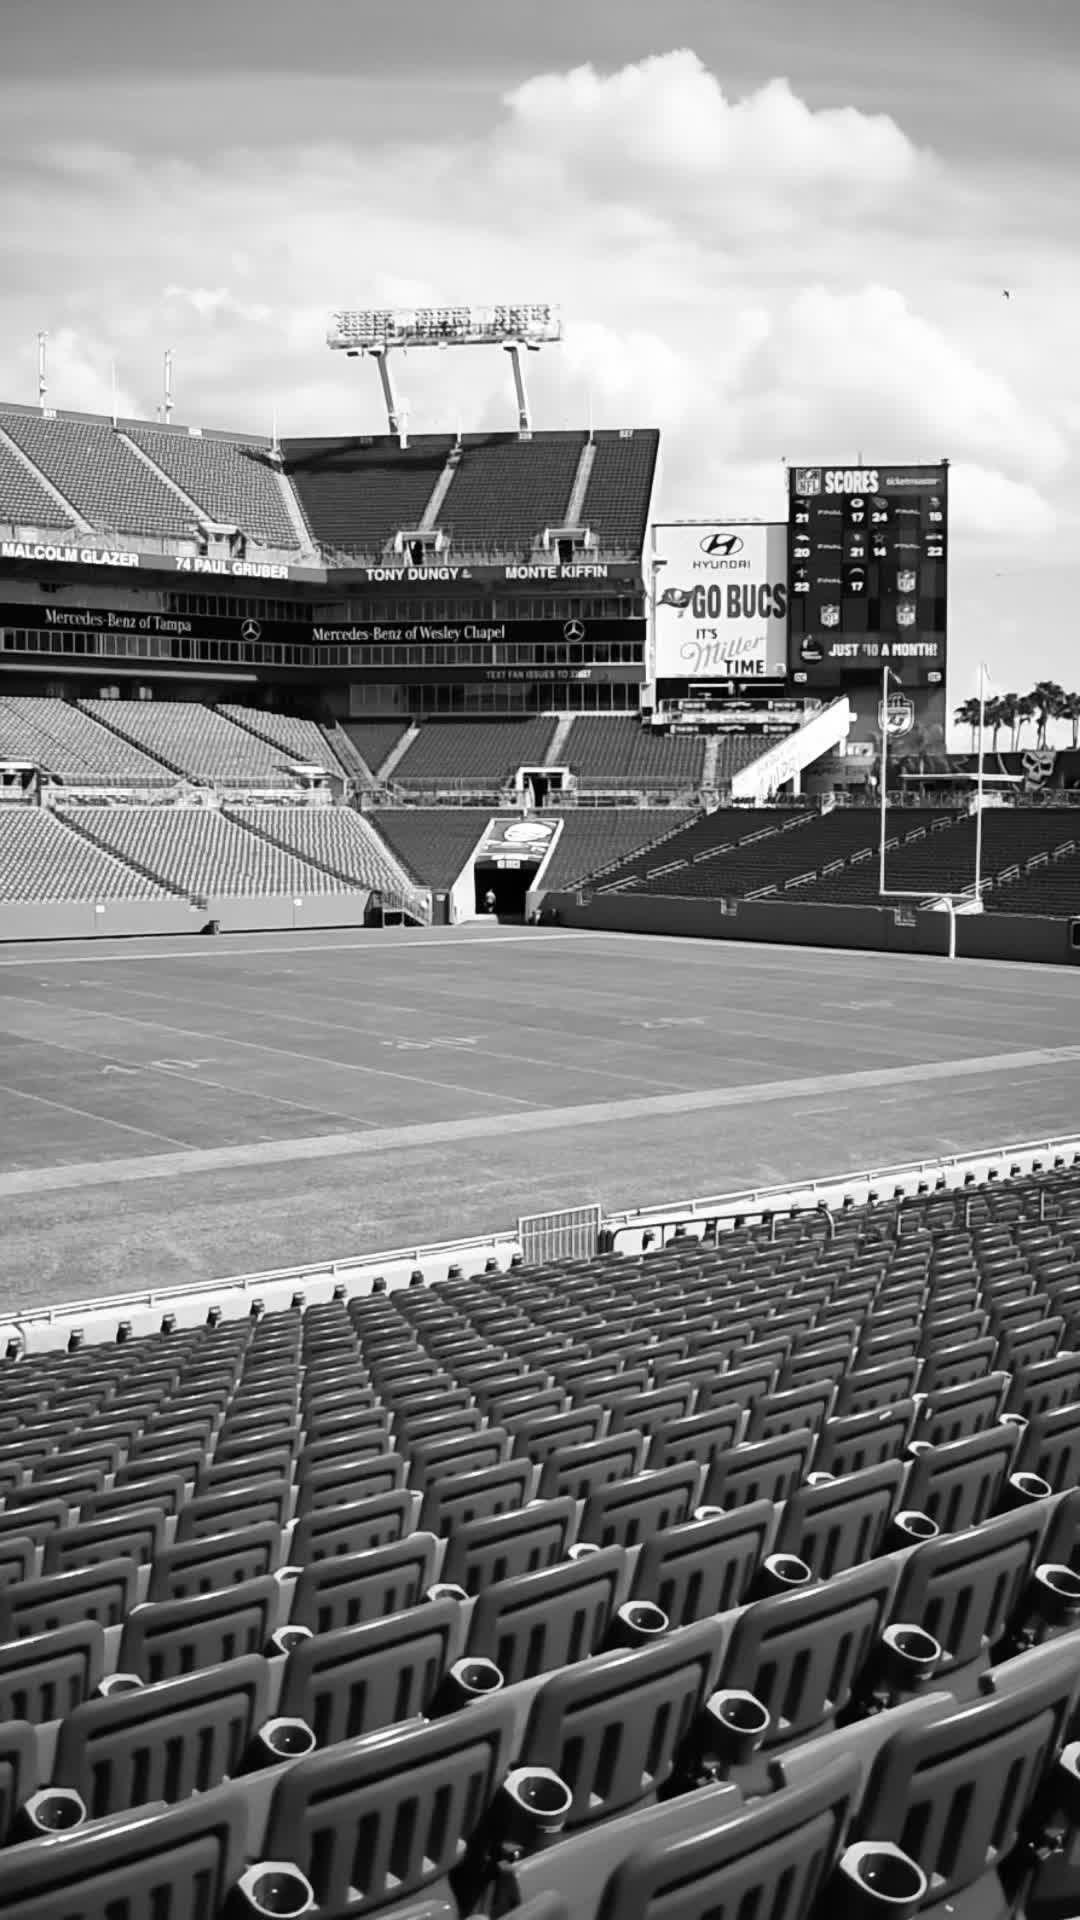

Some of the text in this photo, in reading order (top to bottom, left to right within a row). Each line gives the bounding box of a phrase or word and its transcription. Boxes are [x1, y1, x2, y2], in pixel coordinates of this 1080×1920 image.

[825, 470, 879, 494] SCORES
[795, 513, 809, 523] 21
[851, 512, 865, 523] 17
[871, 512, 888, 522] 24
[1, 542, 140, 567] MALCOLM GLAZER
[850, 547, 864, 557] 21
[873, 547, 887, 557] 14
[927, 546, 943, 557] 22
[176, 557, 289, 580] 74 PAUL GRUBER
[692, 560, 751, 569] HYUNDAI
[366, 567, 459, 581] TONY DUNGY
[505, 565, 608, 580] MONTE KIFFIN
[794, 581, 810, 592] 22
[851, 581, 864, 591] 17
[692, 584, 721, 619] GO
[727, 582, 787, 619] BUCS
[45, 609, 192, 633] Mercedes-Benz of Tampa
[312, 625, 505, 642] Mercedes-Benz of Wesley Chapel
[696, 628, 718, 640] IT'S
[680, 636, 765, 673] Miller
[828, 643, 860, 657] JUST
[881, 643, 890, 657] A
[724, 660, 765, 674] TIME
[508, 670, 525, 679] FAN
